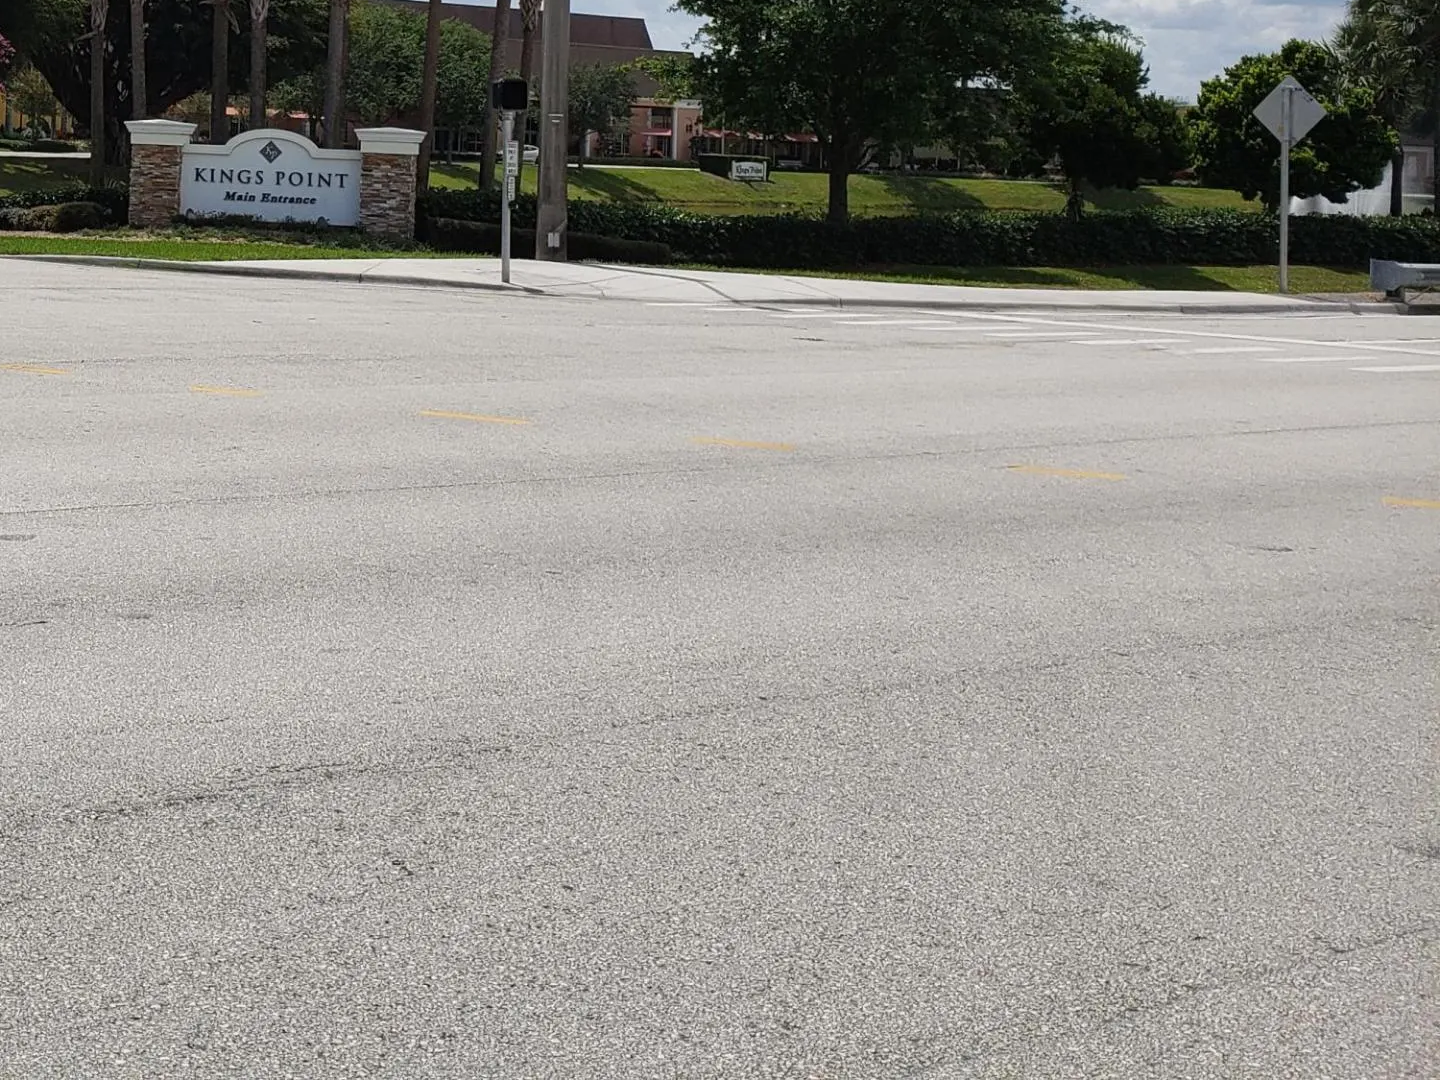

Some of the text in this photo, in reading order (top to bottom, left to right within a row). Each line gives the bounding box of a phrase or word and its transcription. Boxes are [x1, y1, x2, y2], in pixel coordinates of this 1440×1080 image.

[194, 167, 349, 188] KINGS POINT
[223, 191, 317, 205] Main Entrance
